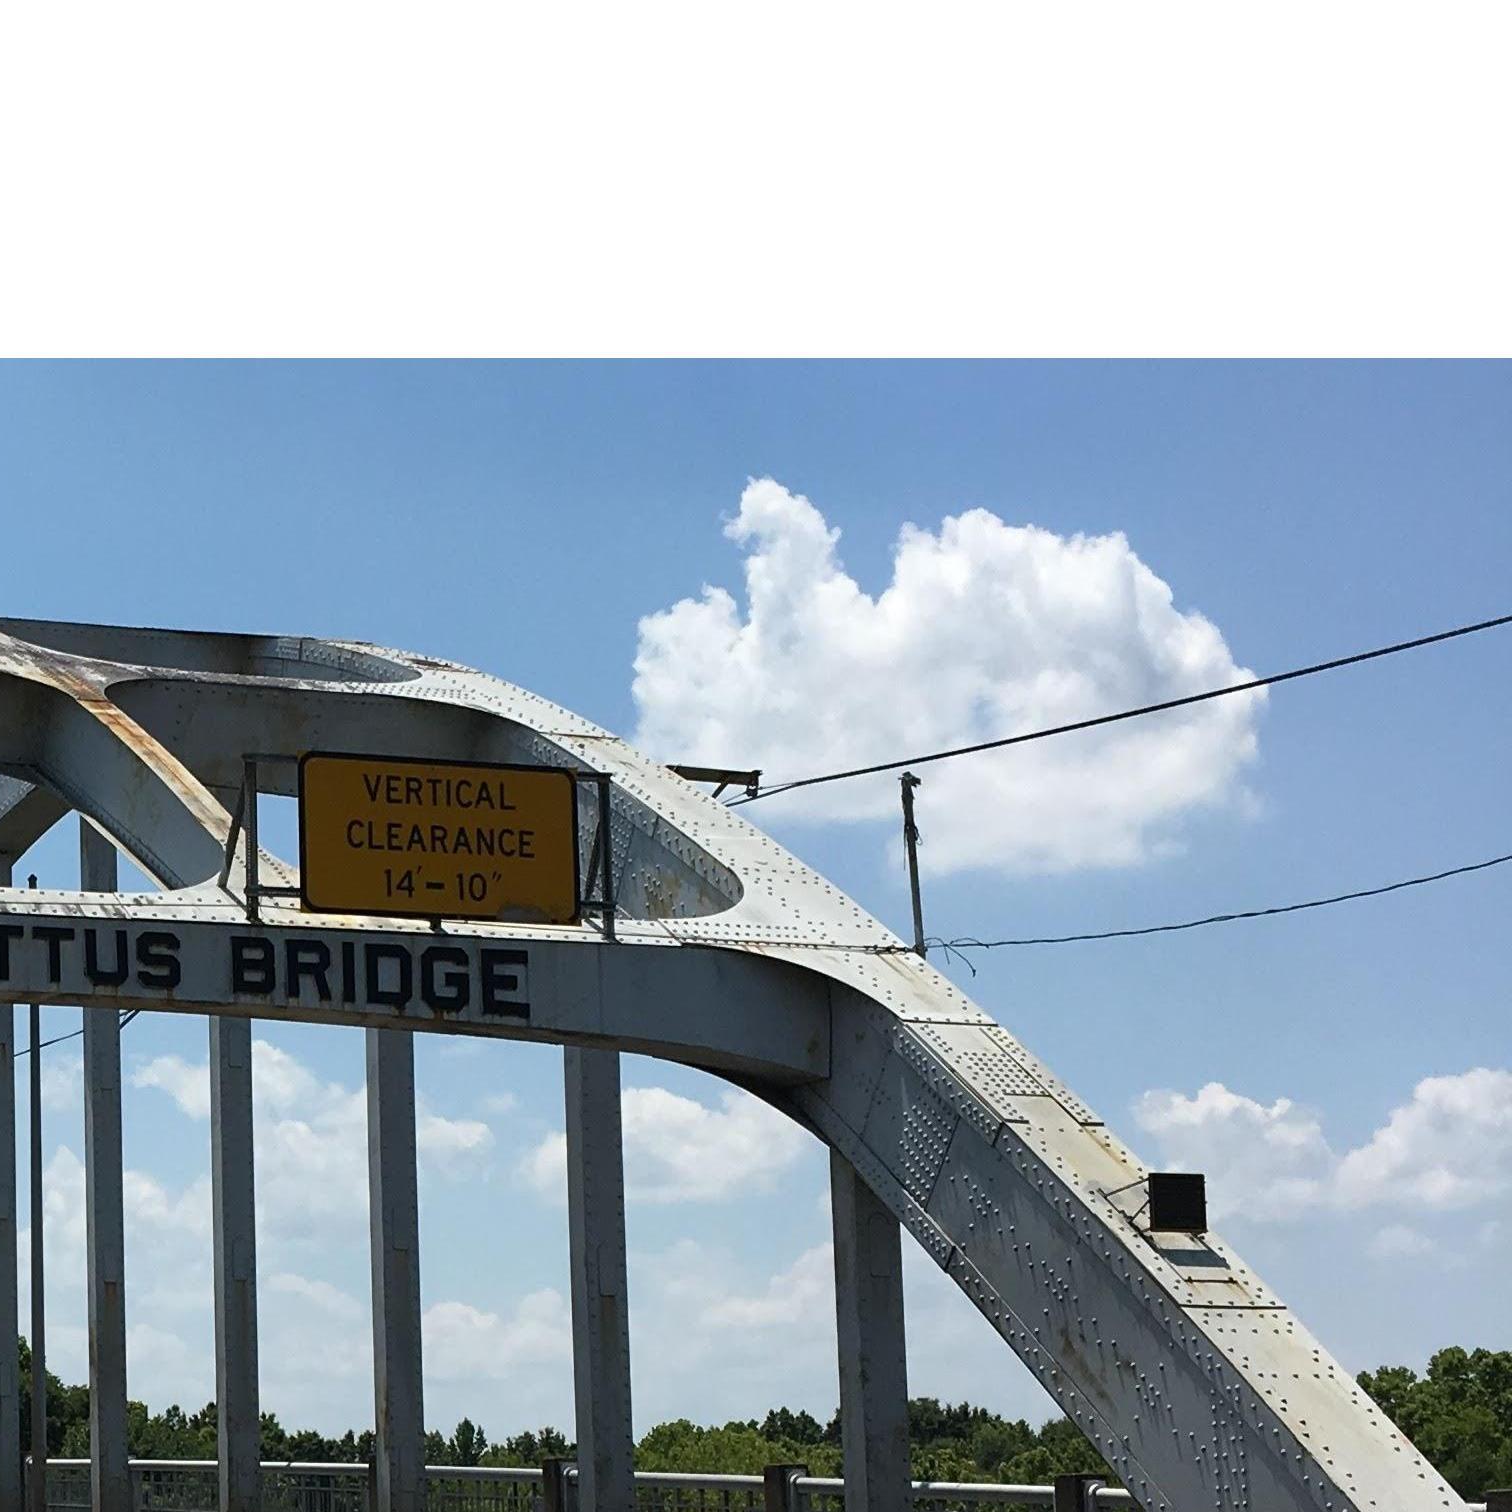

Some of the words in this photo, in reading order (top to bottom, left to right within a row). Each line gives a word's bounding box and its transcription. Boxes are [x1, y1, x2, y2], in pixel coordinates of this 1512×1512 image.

[363, 774, 516, 811] VERTICAL
[346, 820, 535, 858] CLEARANCE
[232, 936, 529, 1018] BRIDGE
